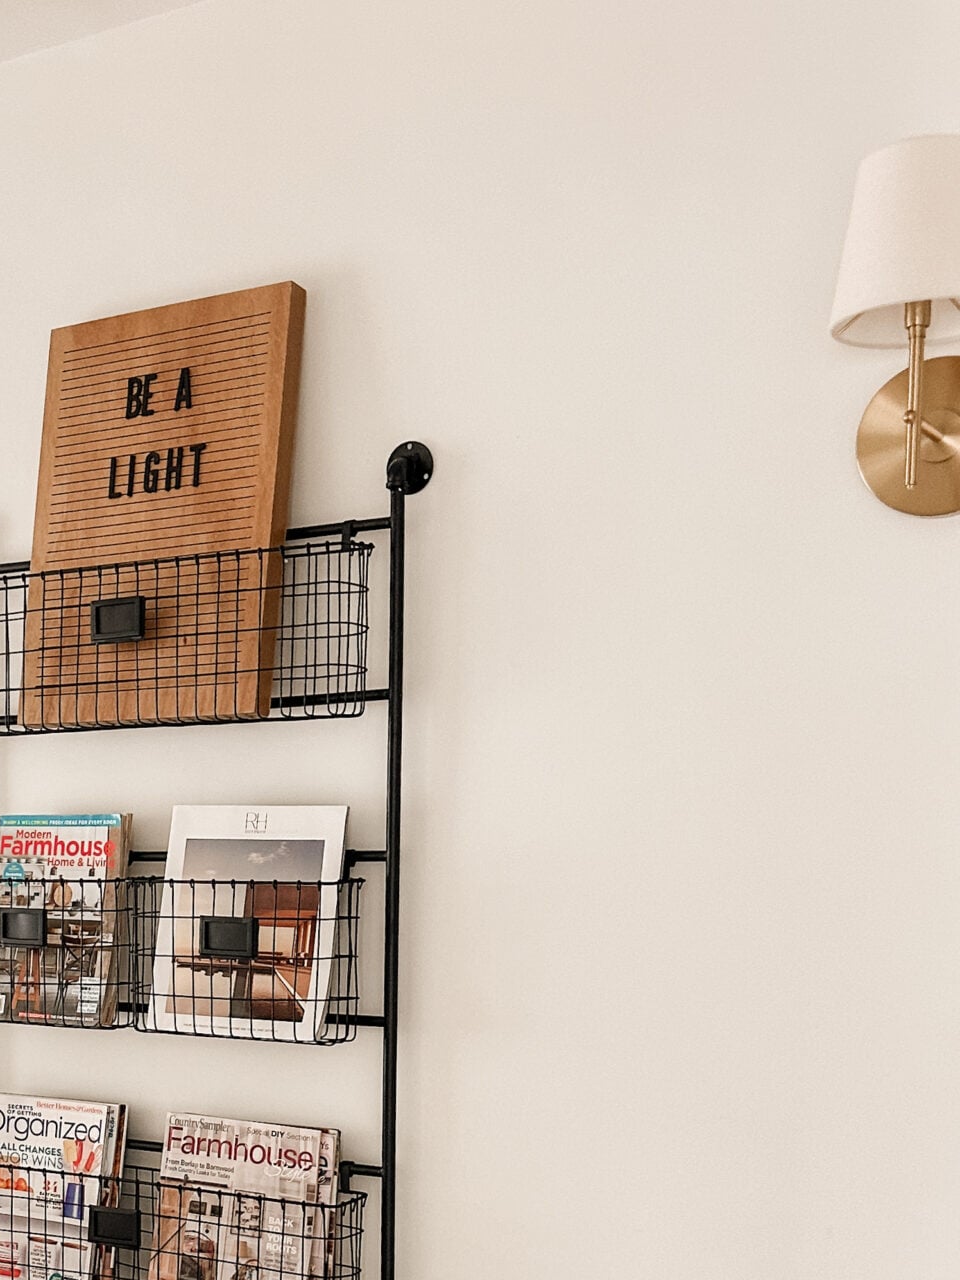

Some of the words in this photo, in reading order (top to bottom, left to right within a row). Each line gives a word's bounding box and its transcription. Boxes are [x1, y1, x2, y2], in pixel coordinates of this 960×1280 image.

[125, 373, 158, 419] BE
[174, 366, 192, 411] A
[108, 443, 207, 499] LIGHT
[244, 812, 268, 830] RH
[16, 829, 52, 839] Modern
[0, 835, 116, 857] Farmhouse
[47, 857, 75, 867] Home
[77, 858, 84, 867] &
[7, 1104, 34, 1112] SECRETS
[16, 1110, 42, 1118] GETTING
[271, 1130, 286, 1139] DIY
[18, 1144, 62, 1157] CHANGES
[167, 1126, 313, 1171] Farmhouse
[31, 1155, 64, 1170] WINS
[268, 1216, 294, 1228] BACK
